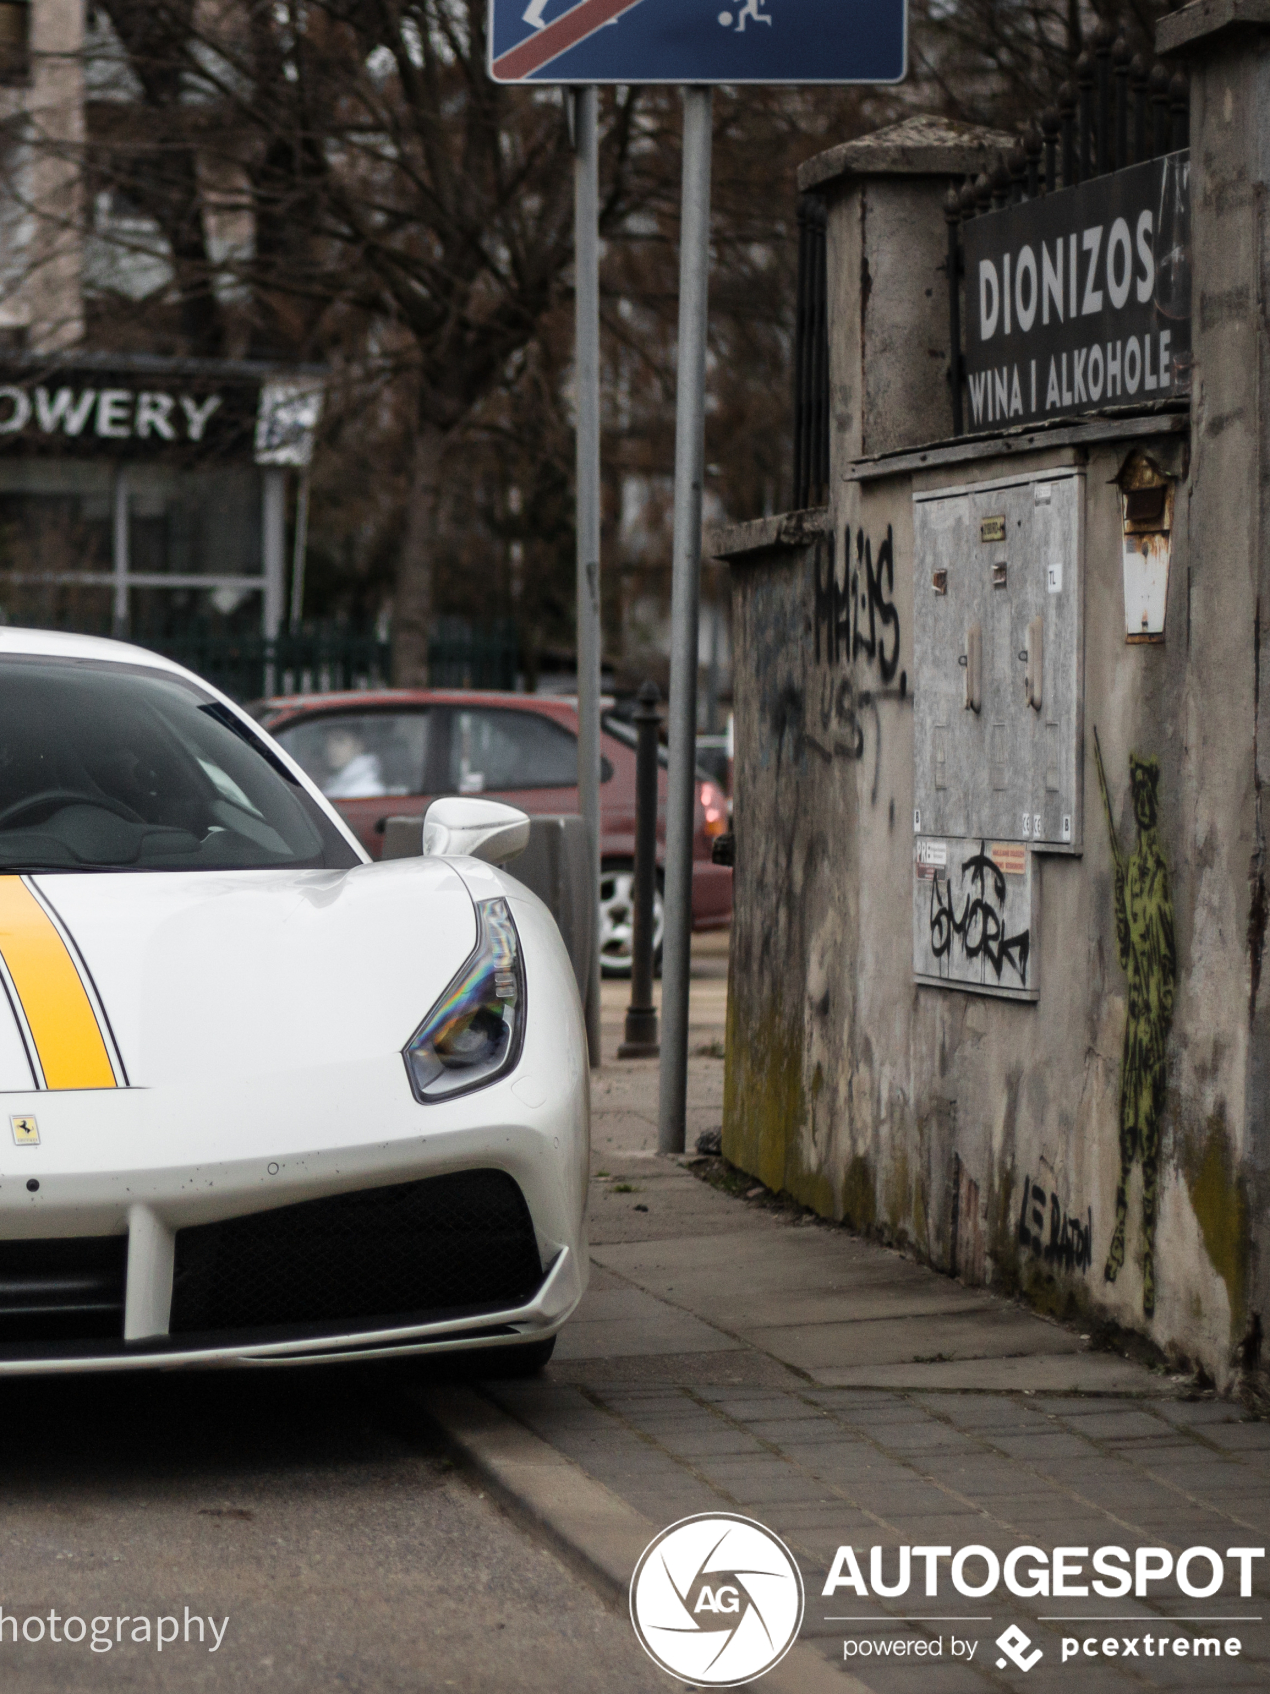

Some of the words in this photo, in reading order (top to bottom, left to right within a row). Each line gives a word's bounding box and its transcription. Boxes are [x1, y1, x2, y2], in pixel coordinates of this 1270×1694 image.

[979, 209, 1154, 341] DIONIZOS
[968, 363, 1023, 426] WINA
[1031, 359, 1036, 413] I
[1046, 329, 1171, 411] ALKOHOLE
